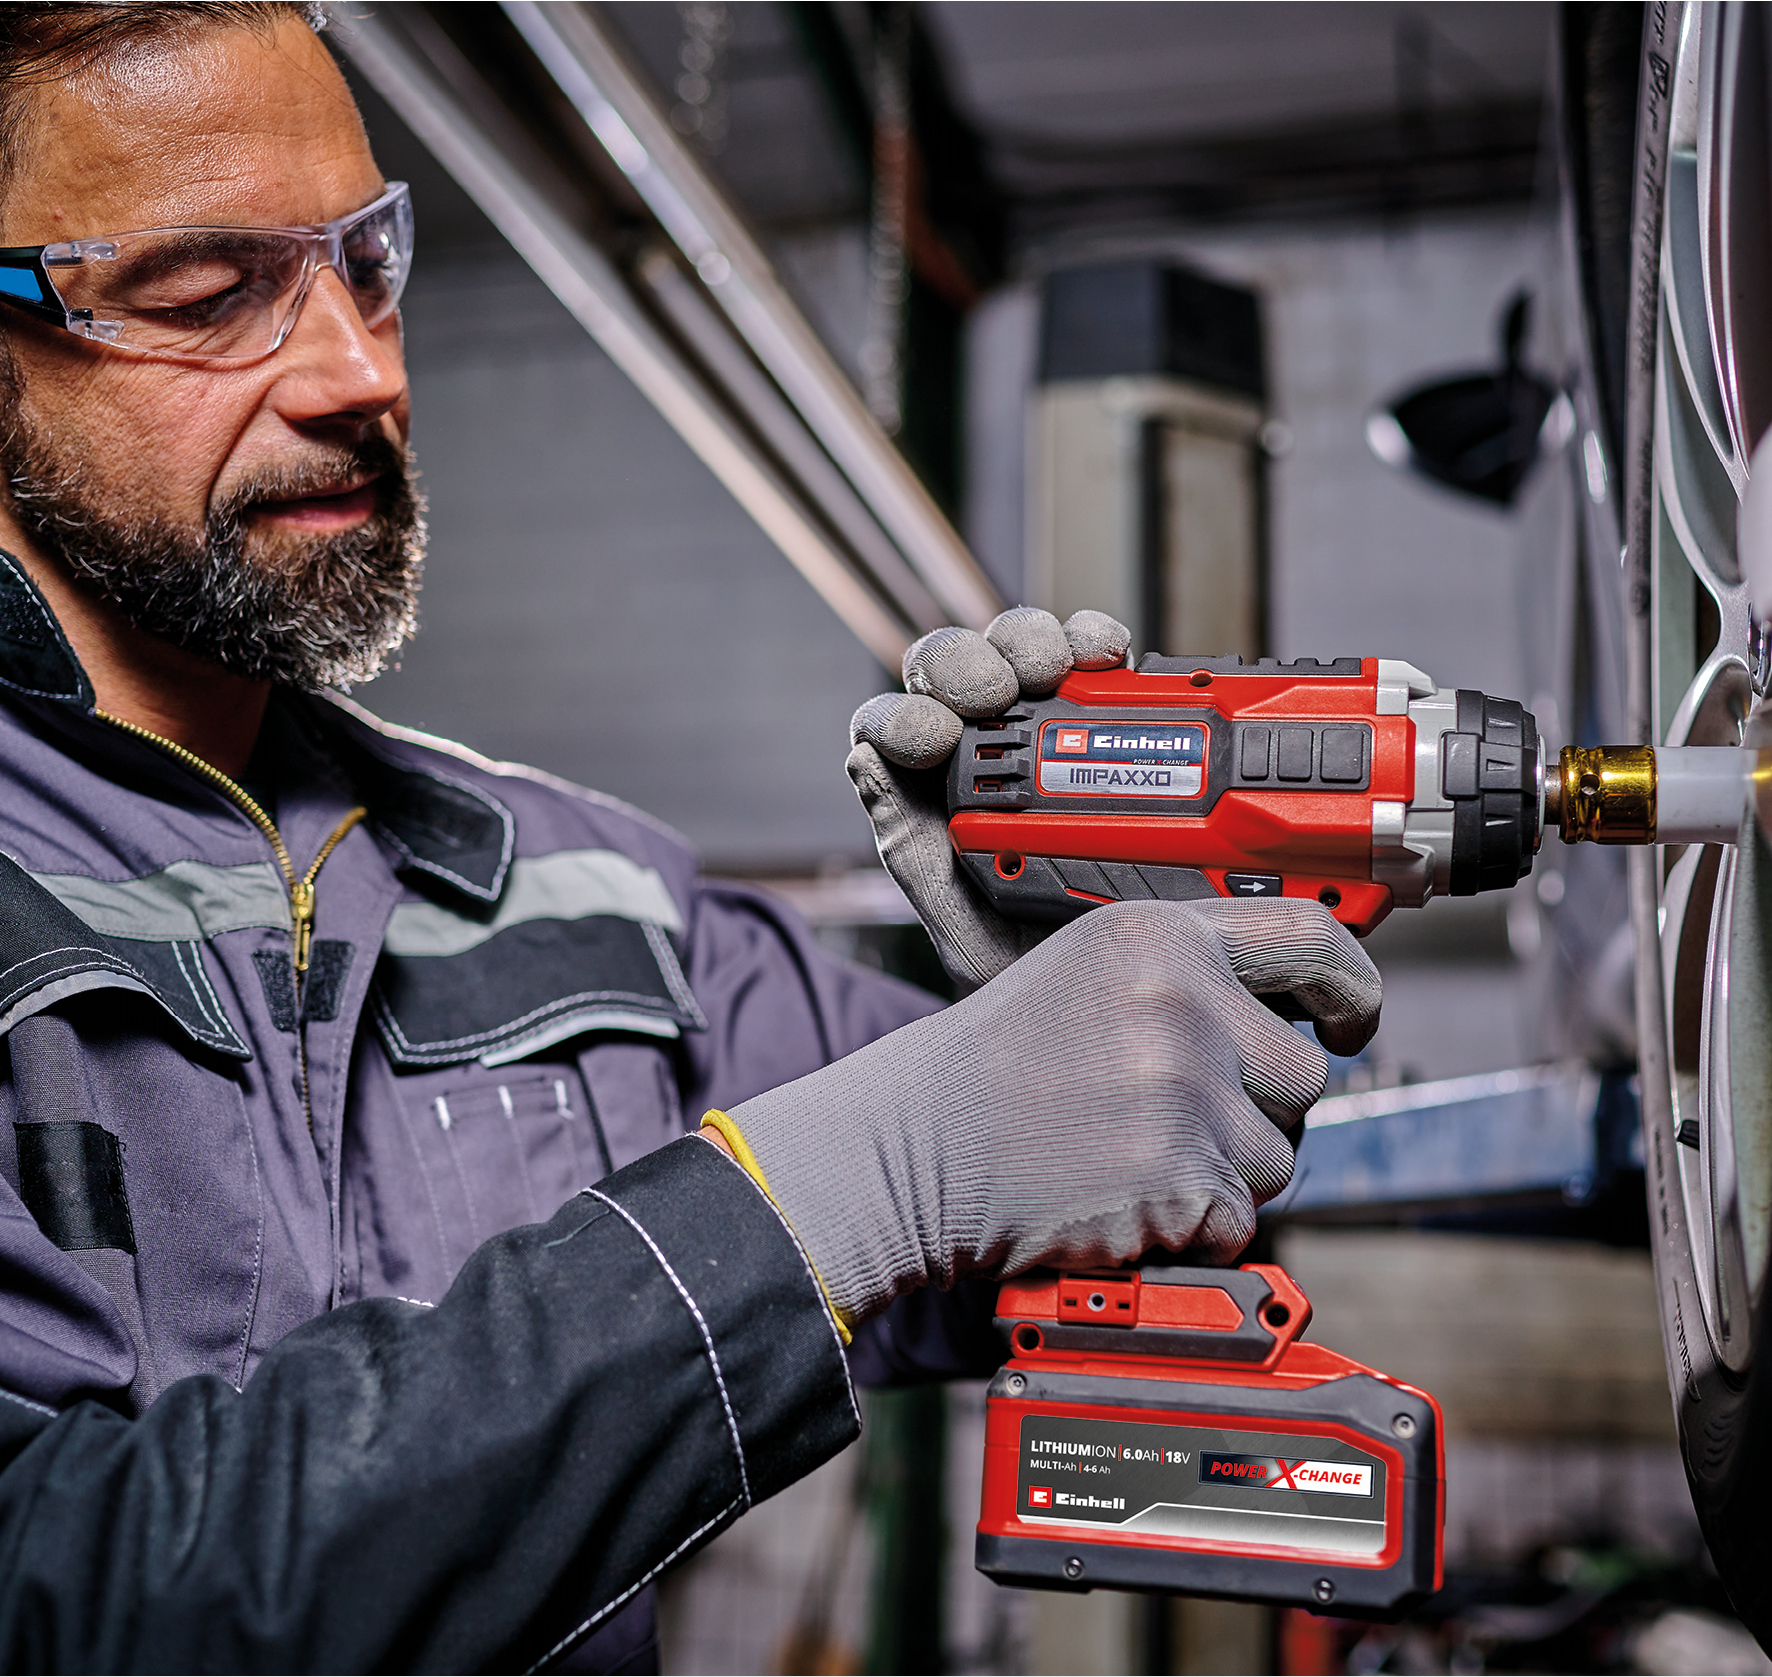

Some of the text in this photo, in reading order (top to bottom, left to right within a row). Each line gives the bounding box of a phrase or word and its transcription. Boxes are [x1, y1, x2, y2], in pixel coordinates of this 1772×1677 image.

[1093, 735, 1191, 751] Einhell
[1070, 768, 1171, 786] IMPAXXO
[1030, 1440, 1191, 1465] LITHIUMION 6.0Ah 18V
[1029, 1460, 1111, 1475] MULTI-Ah 4-6 Ah
[1210, 1461, 1268, 1479] POWER
[1055, 1492, 1126, 1510] Einhell
